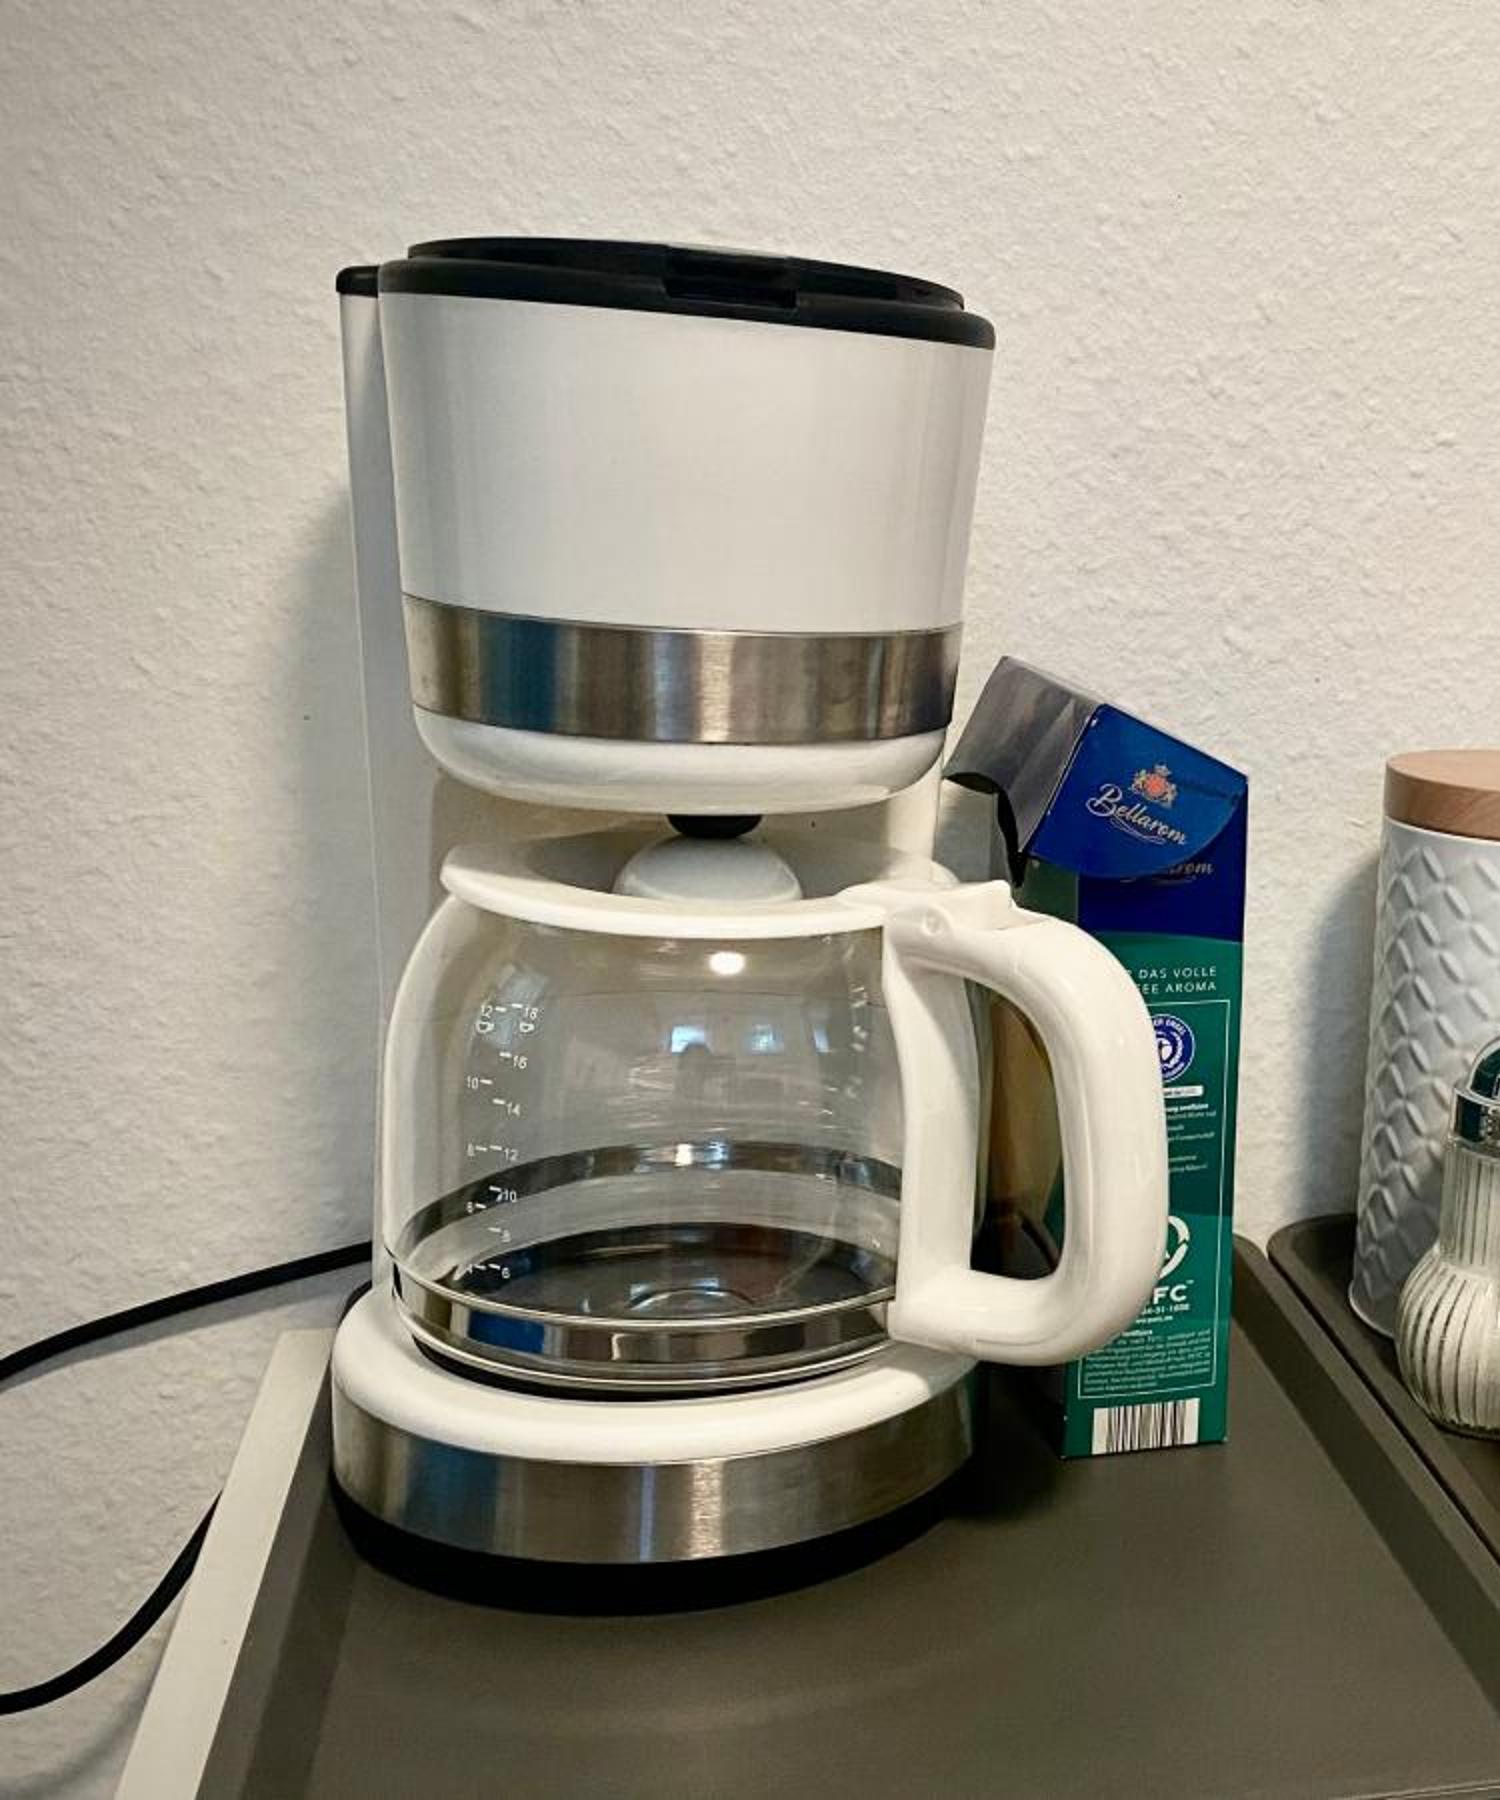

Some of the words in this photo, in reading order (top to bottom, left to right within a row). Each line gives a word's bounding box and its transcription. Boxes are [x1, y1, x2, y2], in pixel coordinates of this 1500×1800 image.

[1085, 783, 1187, 845] Bellarom
[1139, 968, 1167, 979] DAS
[1173, 966, 1217, 977] VOLLE
[1165, 981, 1217, 993] AROMA
[467, 1076, 479, 1089] 10
[507, 1102, 520, 1116] 14
[504, 1148, 518, 1161] 12
